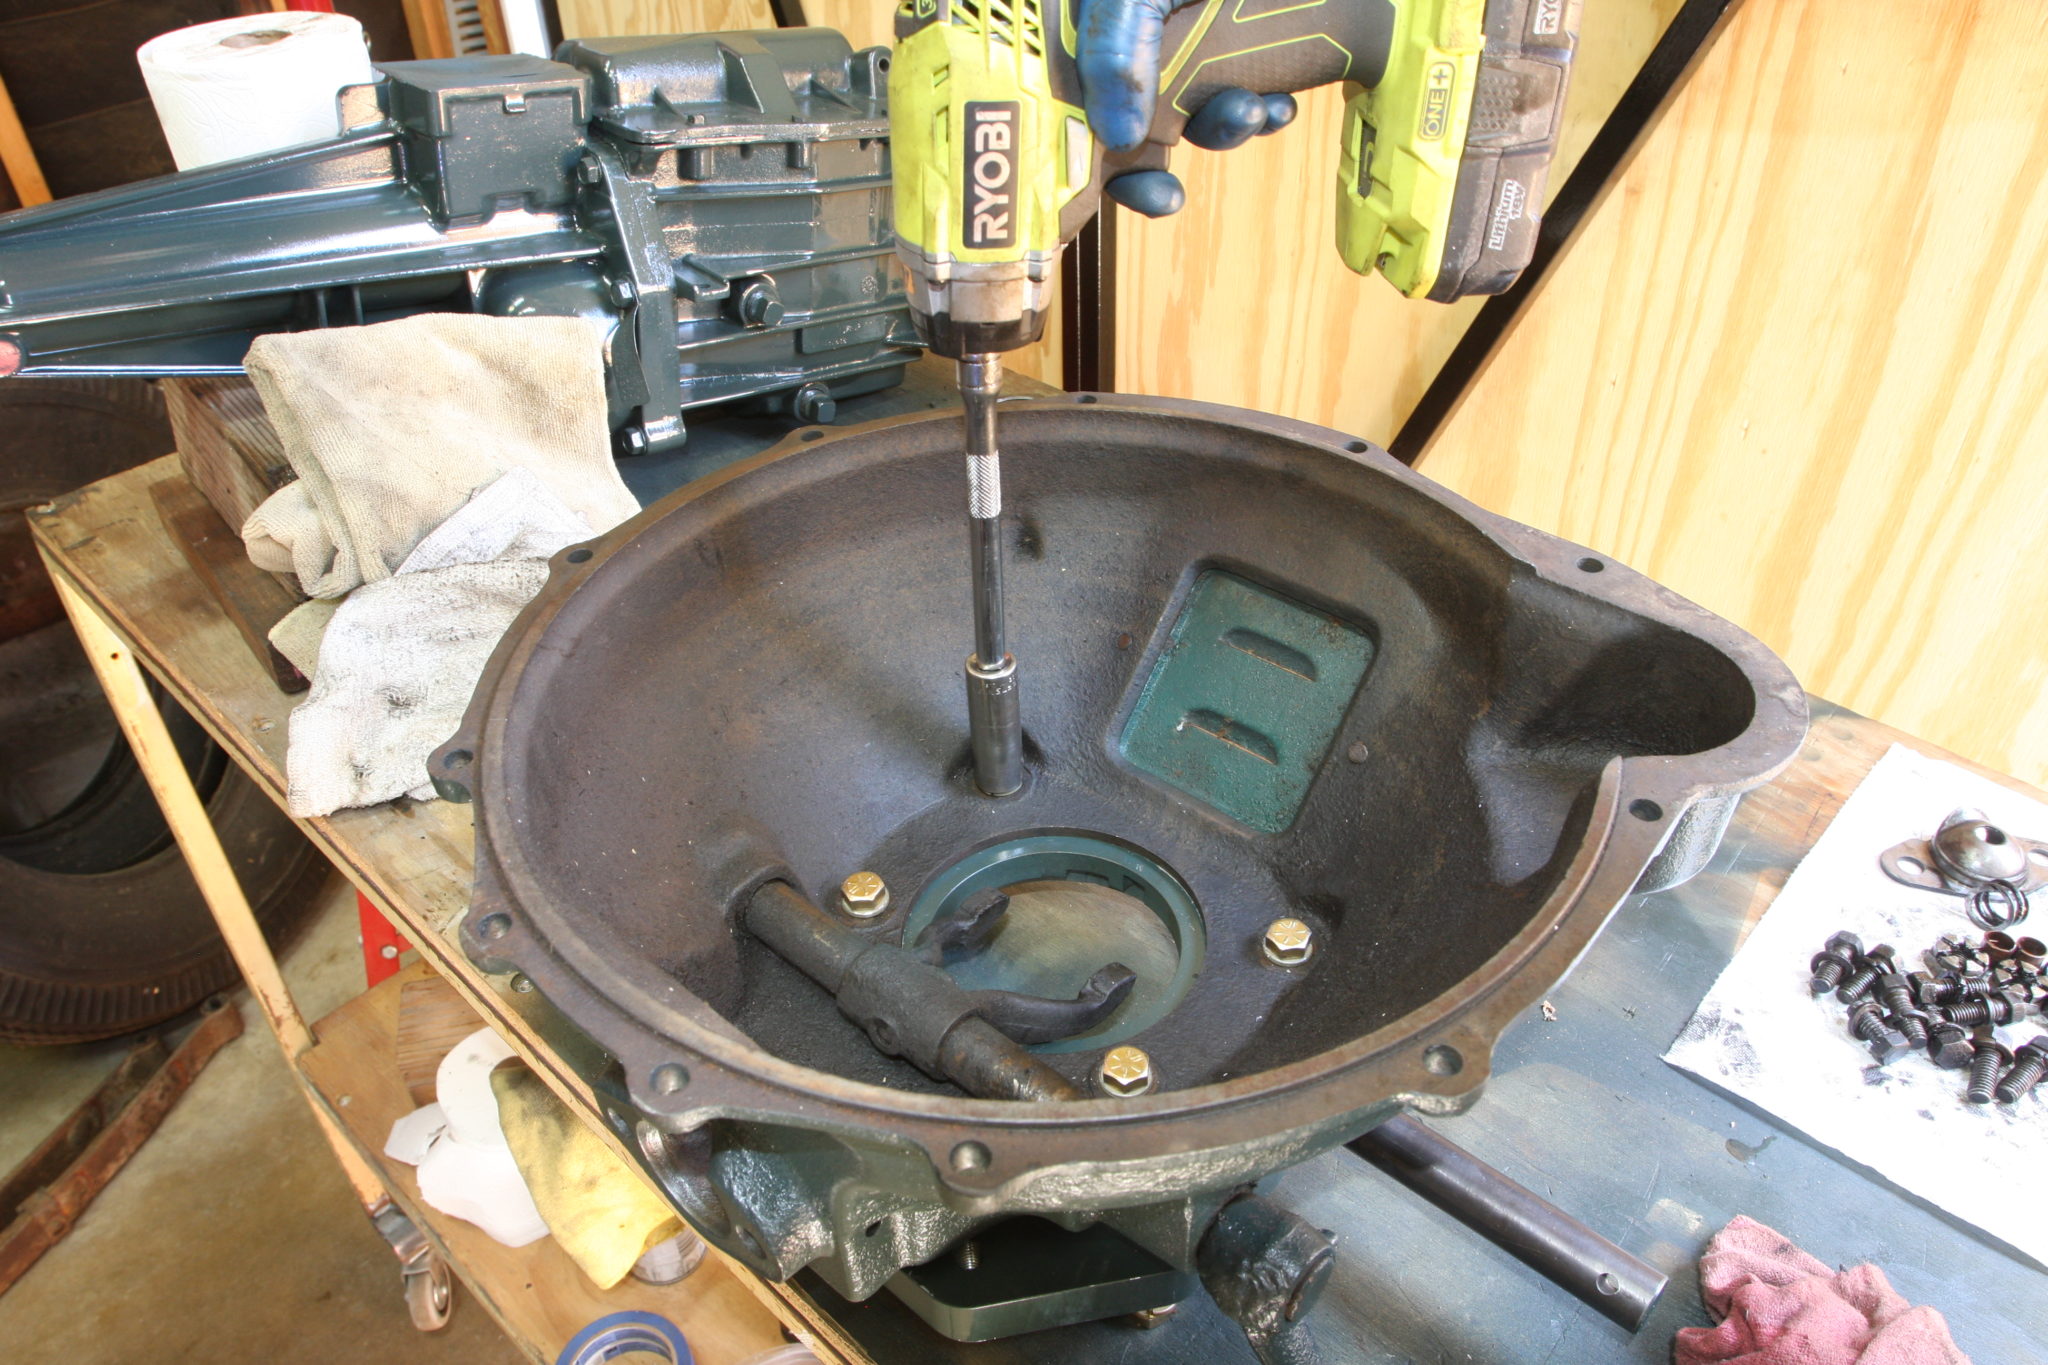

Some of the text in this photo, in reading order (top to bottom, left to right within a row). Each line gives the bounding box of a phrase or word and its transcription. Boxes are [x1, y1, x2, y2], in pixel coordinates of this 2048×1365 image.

[1539, 0, 1558, 31] RY
[973, 111, 1011, 243] RYOBI
[1510, 185, 1525, 218] 18V
[1490, 181, 1515, 249] Lithium
